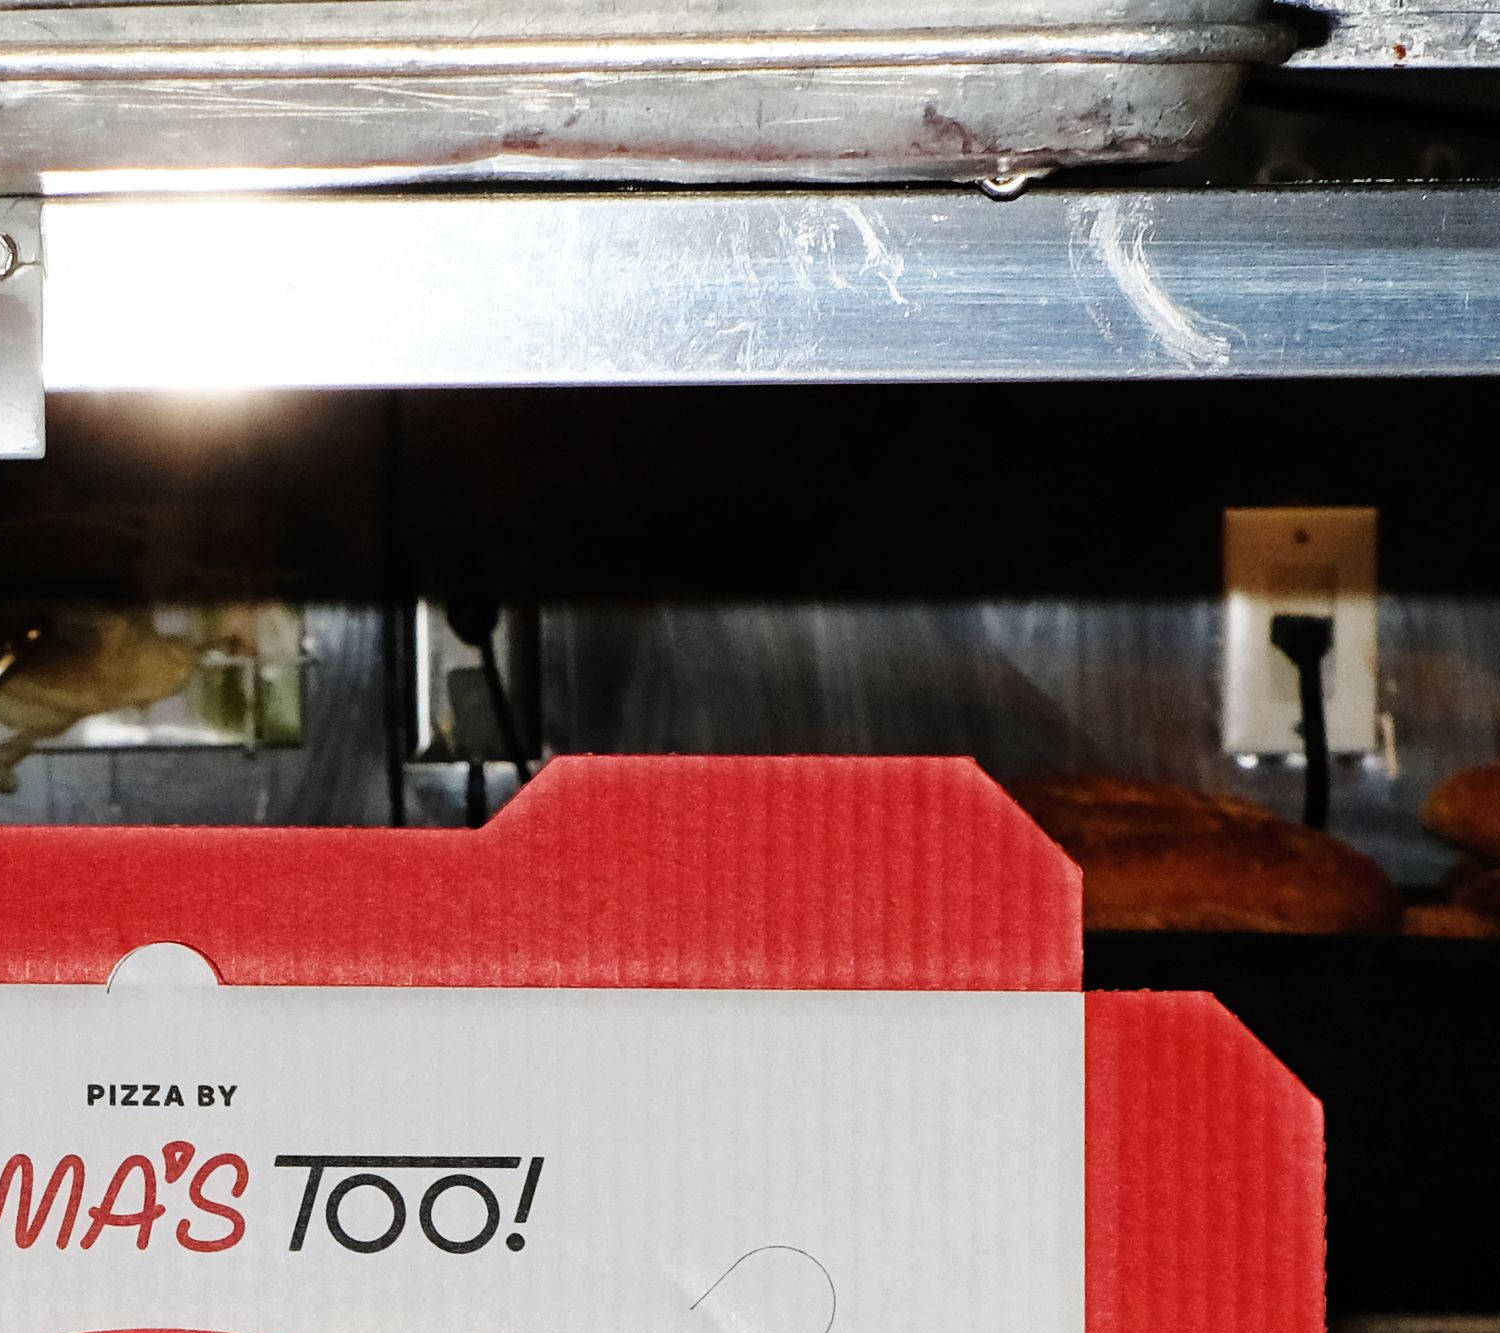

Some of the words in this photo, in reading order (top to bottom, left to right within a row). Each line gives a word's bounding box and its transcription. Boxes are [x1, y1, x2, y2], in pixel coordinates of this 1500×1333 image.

[87, 1085, 185, 1107] PIZZA
[198, 1085, 238, 1107] BY
[274, 1155, 545, 1254] TOO!
